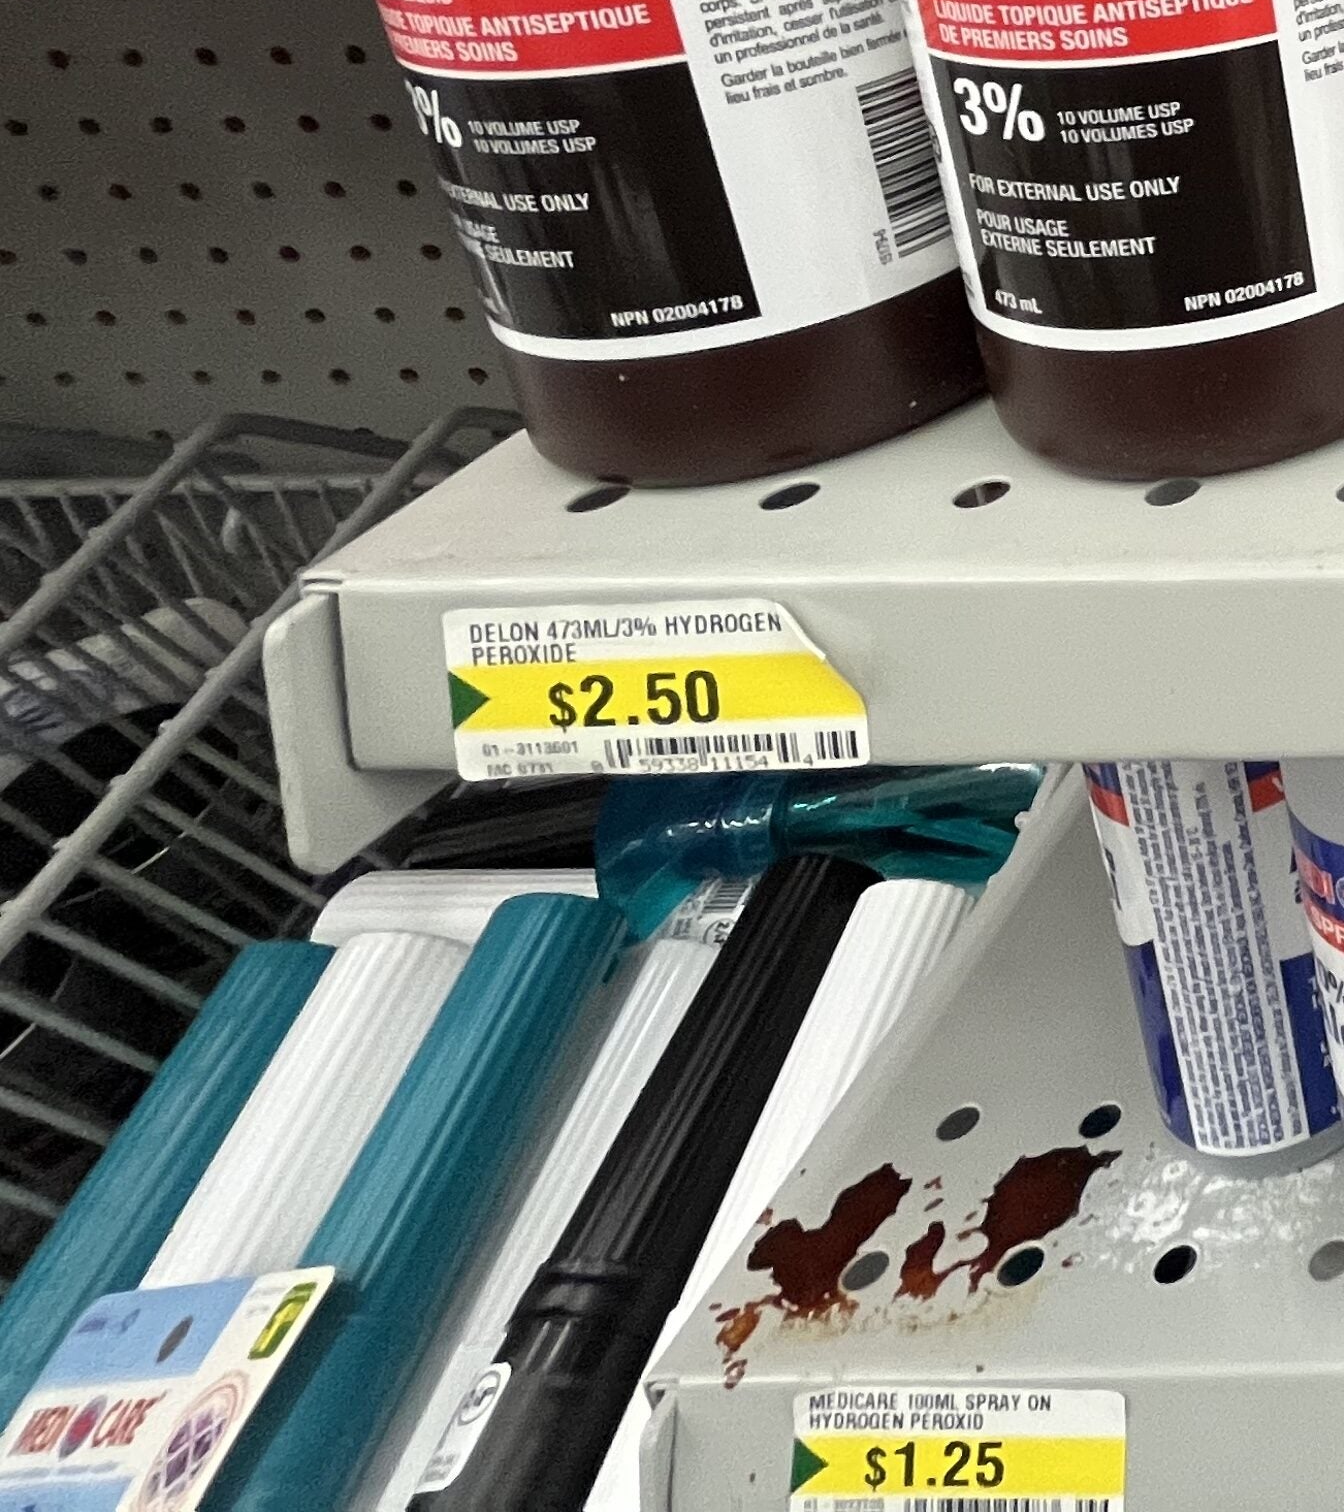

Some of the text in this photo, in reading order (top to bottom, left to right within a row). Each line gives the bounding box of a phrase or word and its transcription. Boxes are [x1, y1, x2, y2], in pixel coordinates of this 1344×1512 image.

[954, 77, 1045, 142] 3%
[1184, 292, 1221, 312] NPN
[470, 613, 781, 643] DELON 473ML/3% HYDROGEN
[472, 643, 576, 666] PEROXIDE
[549, 670, 720, 732] $2.50
[809, 1393, 1051, 1411] MEDICARE 100ML SPRAY ON
[911, 1414, 983, 1429] PEROXID
[865, 1441, 1004, 1491] $1.25
